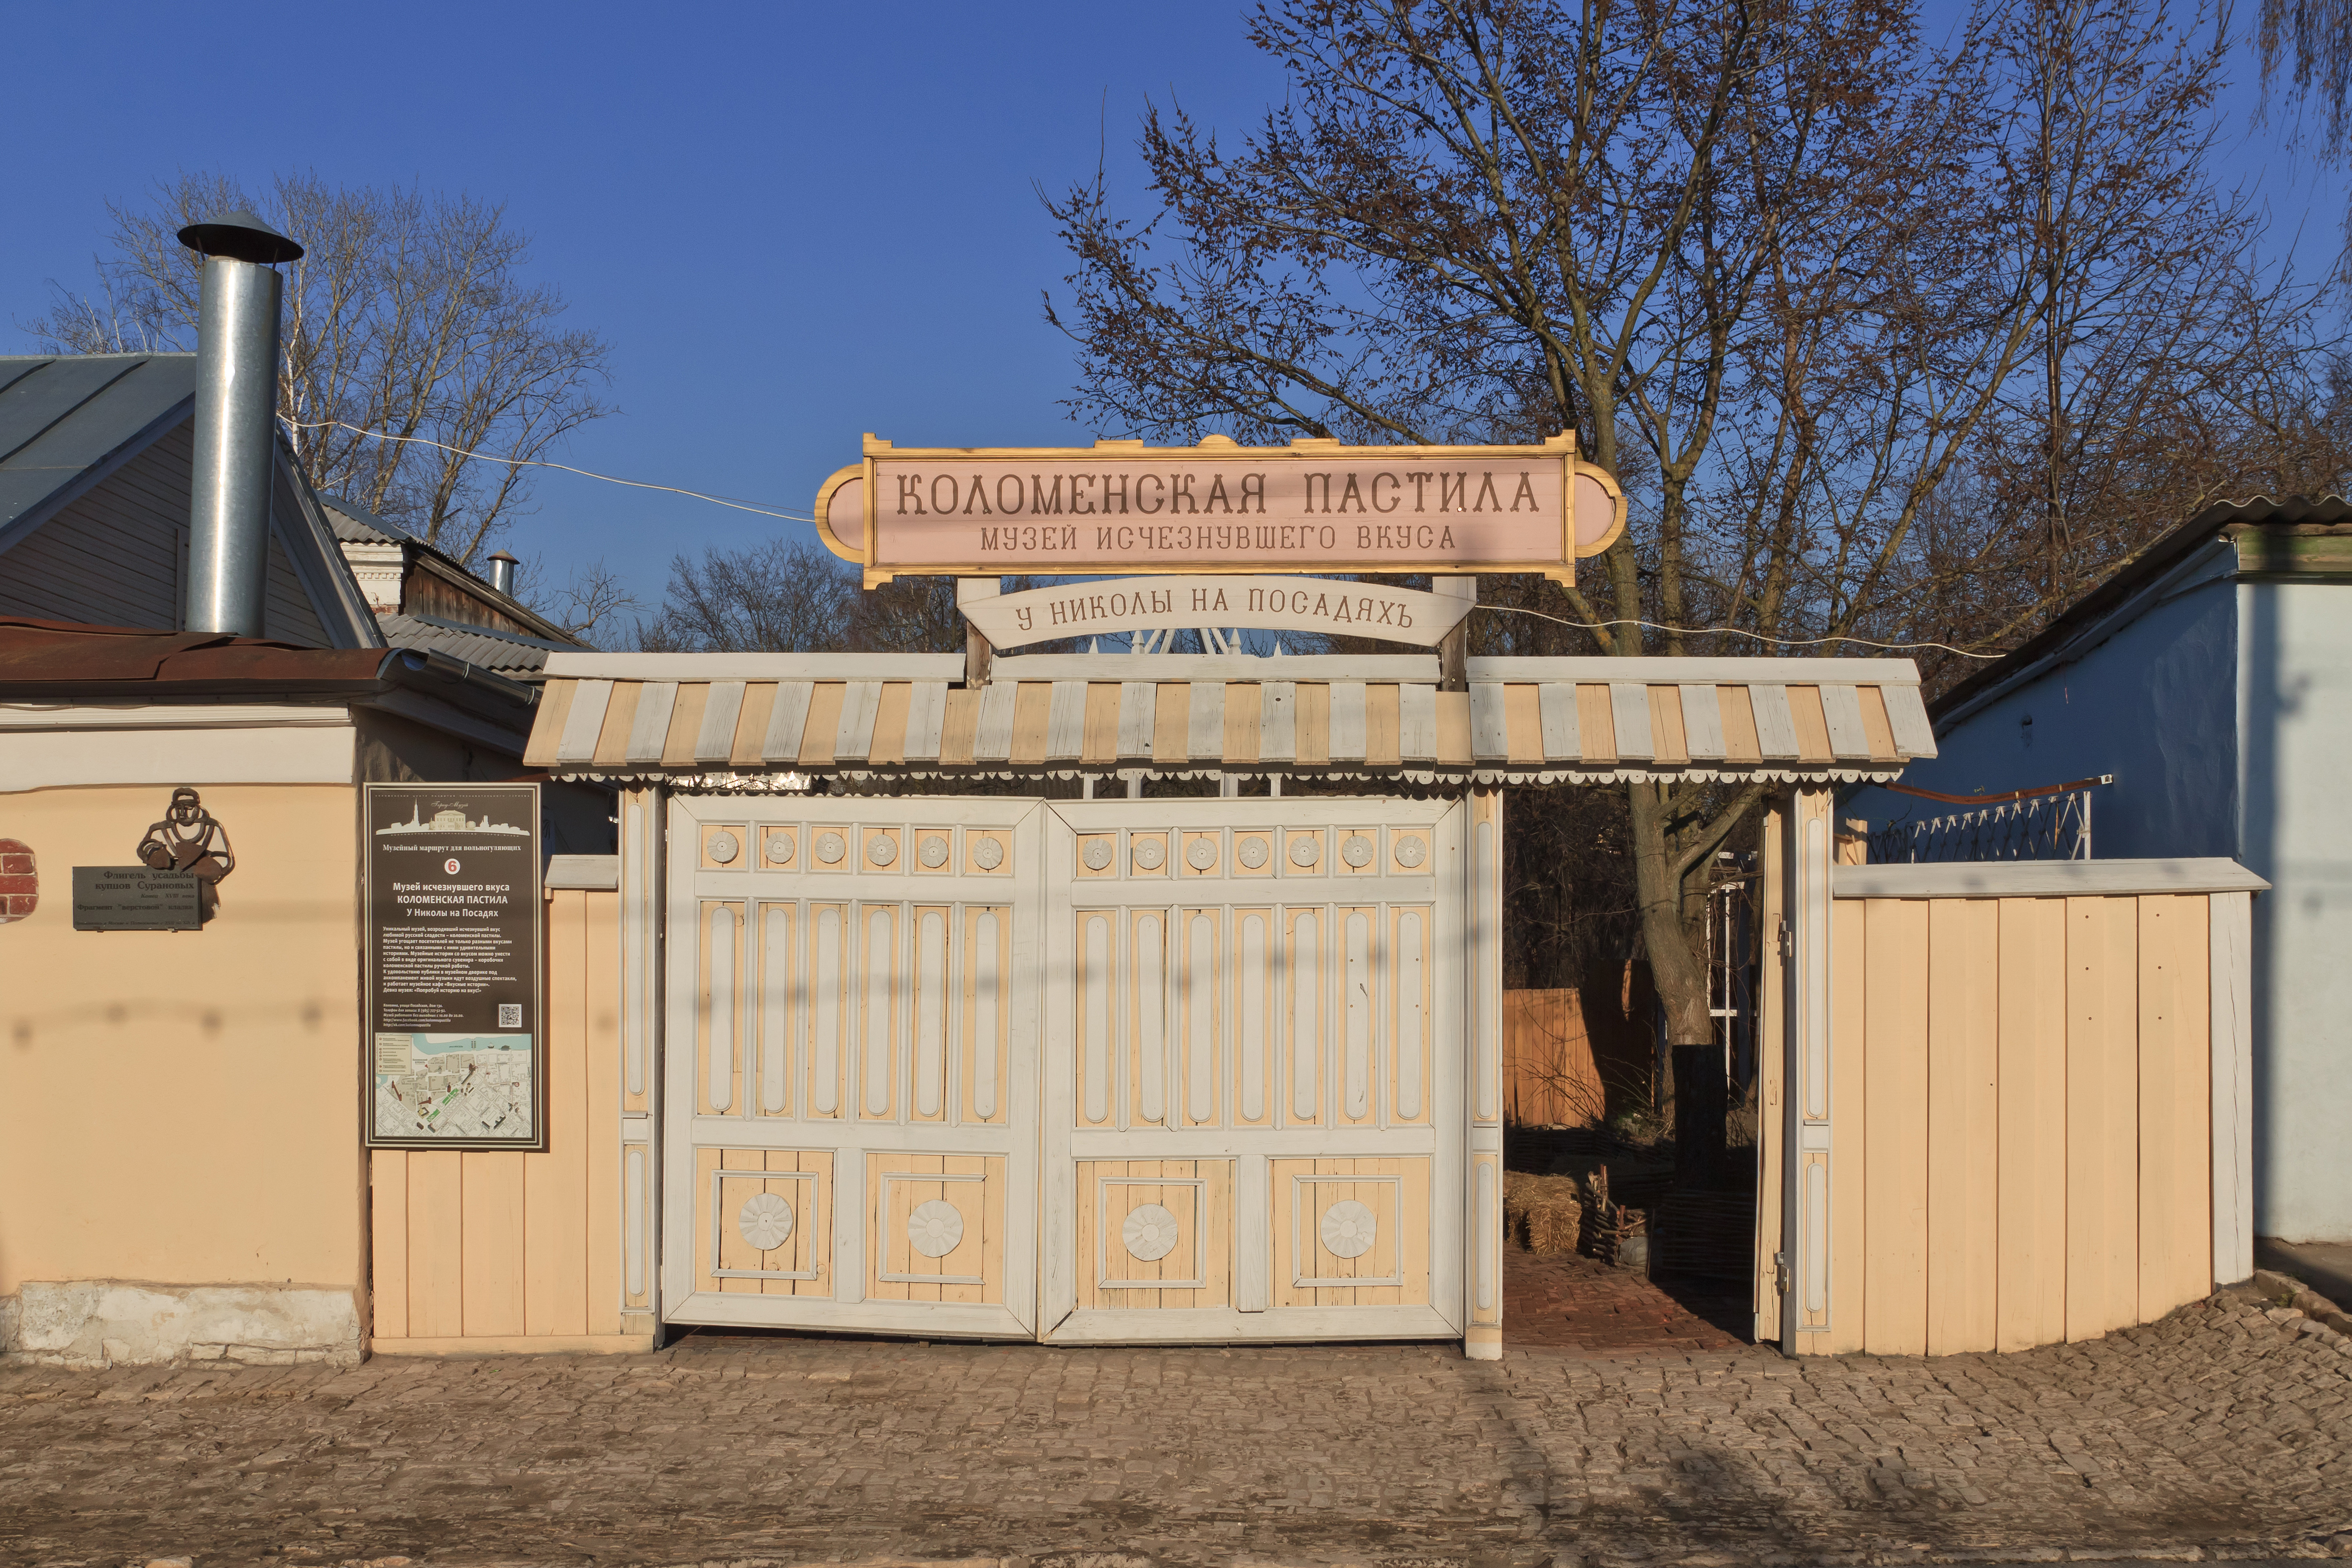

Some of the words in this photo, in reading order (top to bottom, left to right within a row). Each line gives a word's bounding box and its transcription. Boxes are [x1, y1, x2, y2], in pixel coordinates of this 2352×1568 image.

[896, 473, 1267, 515] КОЛОМЕНСКАЯ
[1303, 471, 1540, 514] ПАСТИЛА
[980, 523, 1077, 550] МУЗЕЙ
[1096, 525, 1336, 550] ИСЧЕЗНУВШЕГО
[1357, 525, 1456, 549] ВКУСА
[1015, 606, 1033, 631] У
[1049, 589, 1172, 626] НИКОЛЫ
[1192, 588, 1229, 612] НА
[1248, 588, 1412, 628] ПОСАДЯХЪ
[448, 860, 457, 872] 6
[104, 871, 146, 879] Флигель
[152, 871, 194, 880] усадьбы
[137, 881, 195, 891] Сурановых
[393, 882, 420, 893] Музей
[463, 909, 498, 919] Посадях
